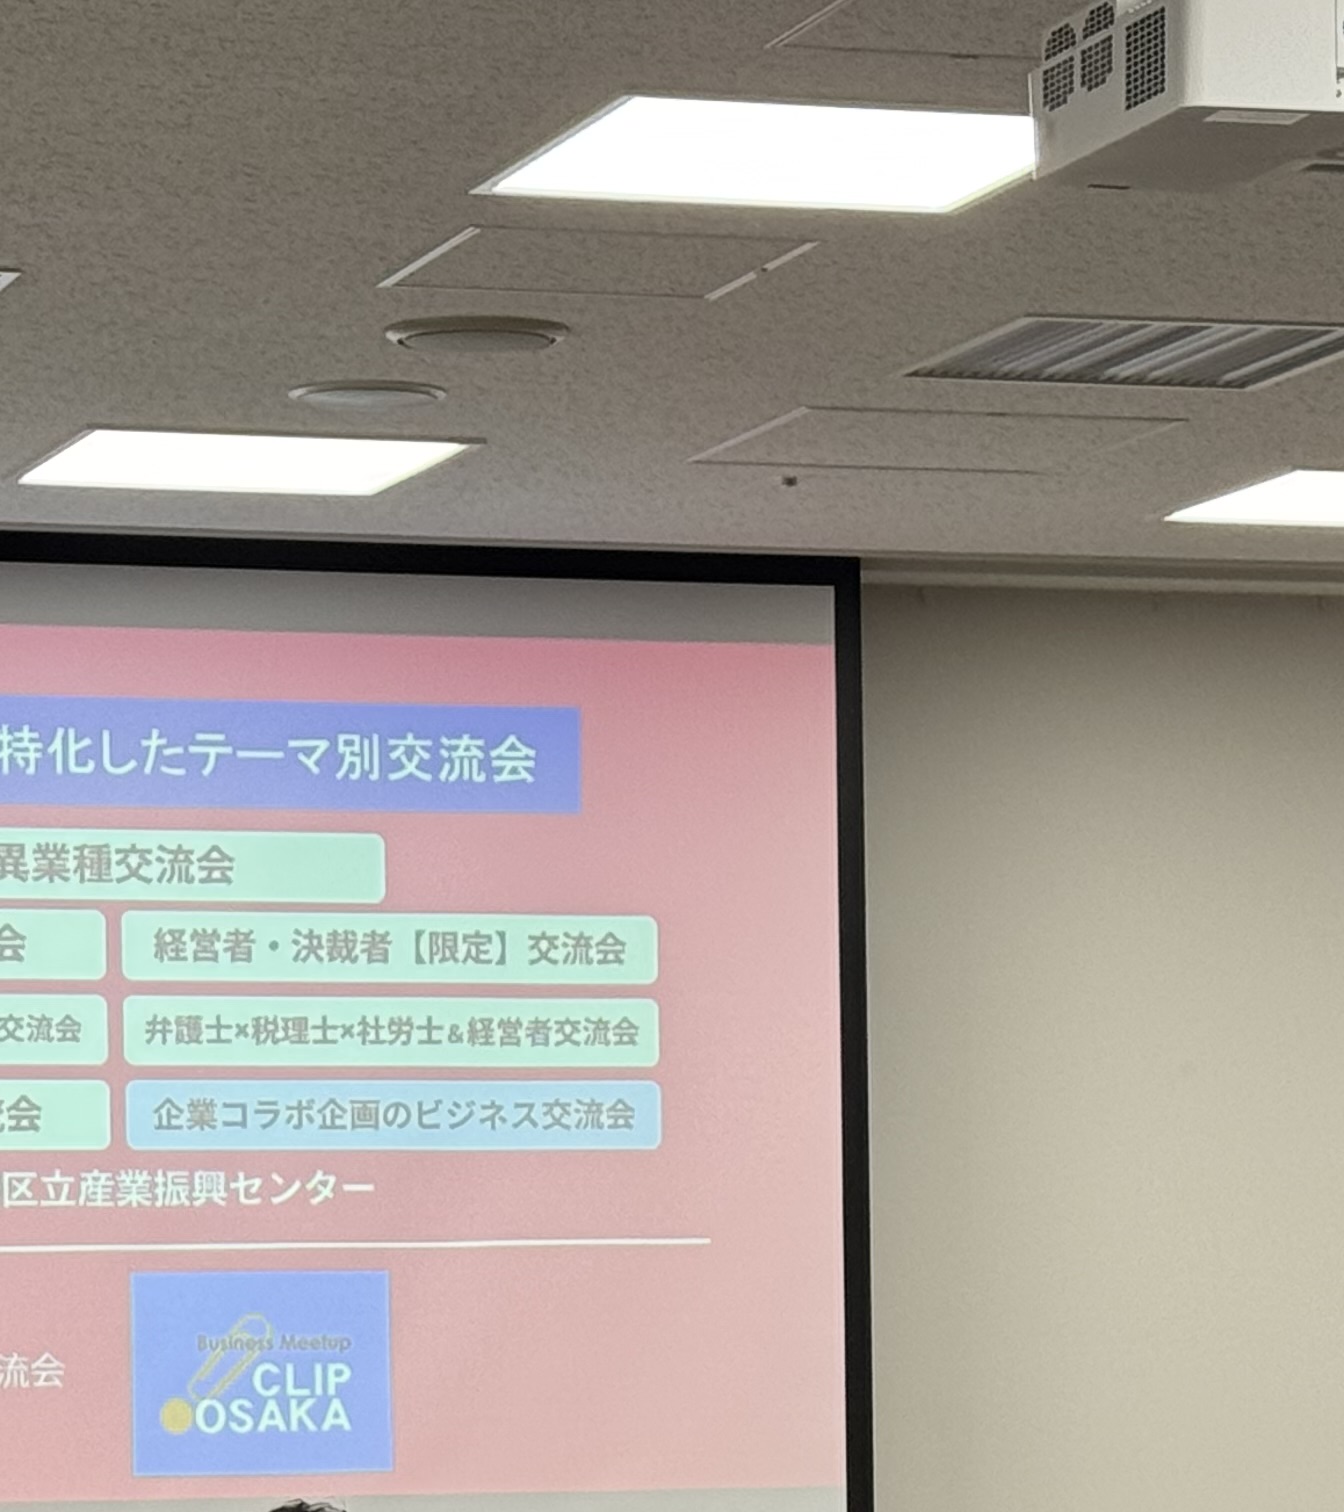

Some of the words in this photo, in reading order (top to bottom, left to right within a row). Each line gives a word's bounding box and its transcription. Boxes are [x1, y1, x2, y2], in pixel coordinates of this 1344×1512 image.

[153, 927, 627, 967] 経営者・決裁者【限定】交流会
[153, 1097, 636, 1132] 企業コラボ企画のビジネス交流会
[196, 1334, 274, 1352] Business
[280, 1334, 352, 1354] Meetup
[252, 1362, 352, 1397] CLIP
[195, 1397, 352, 1435] OSAKA
